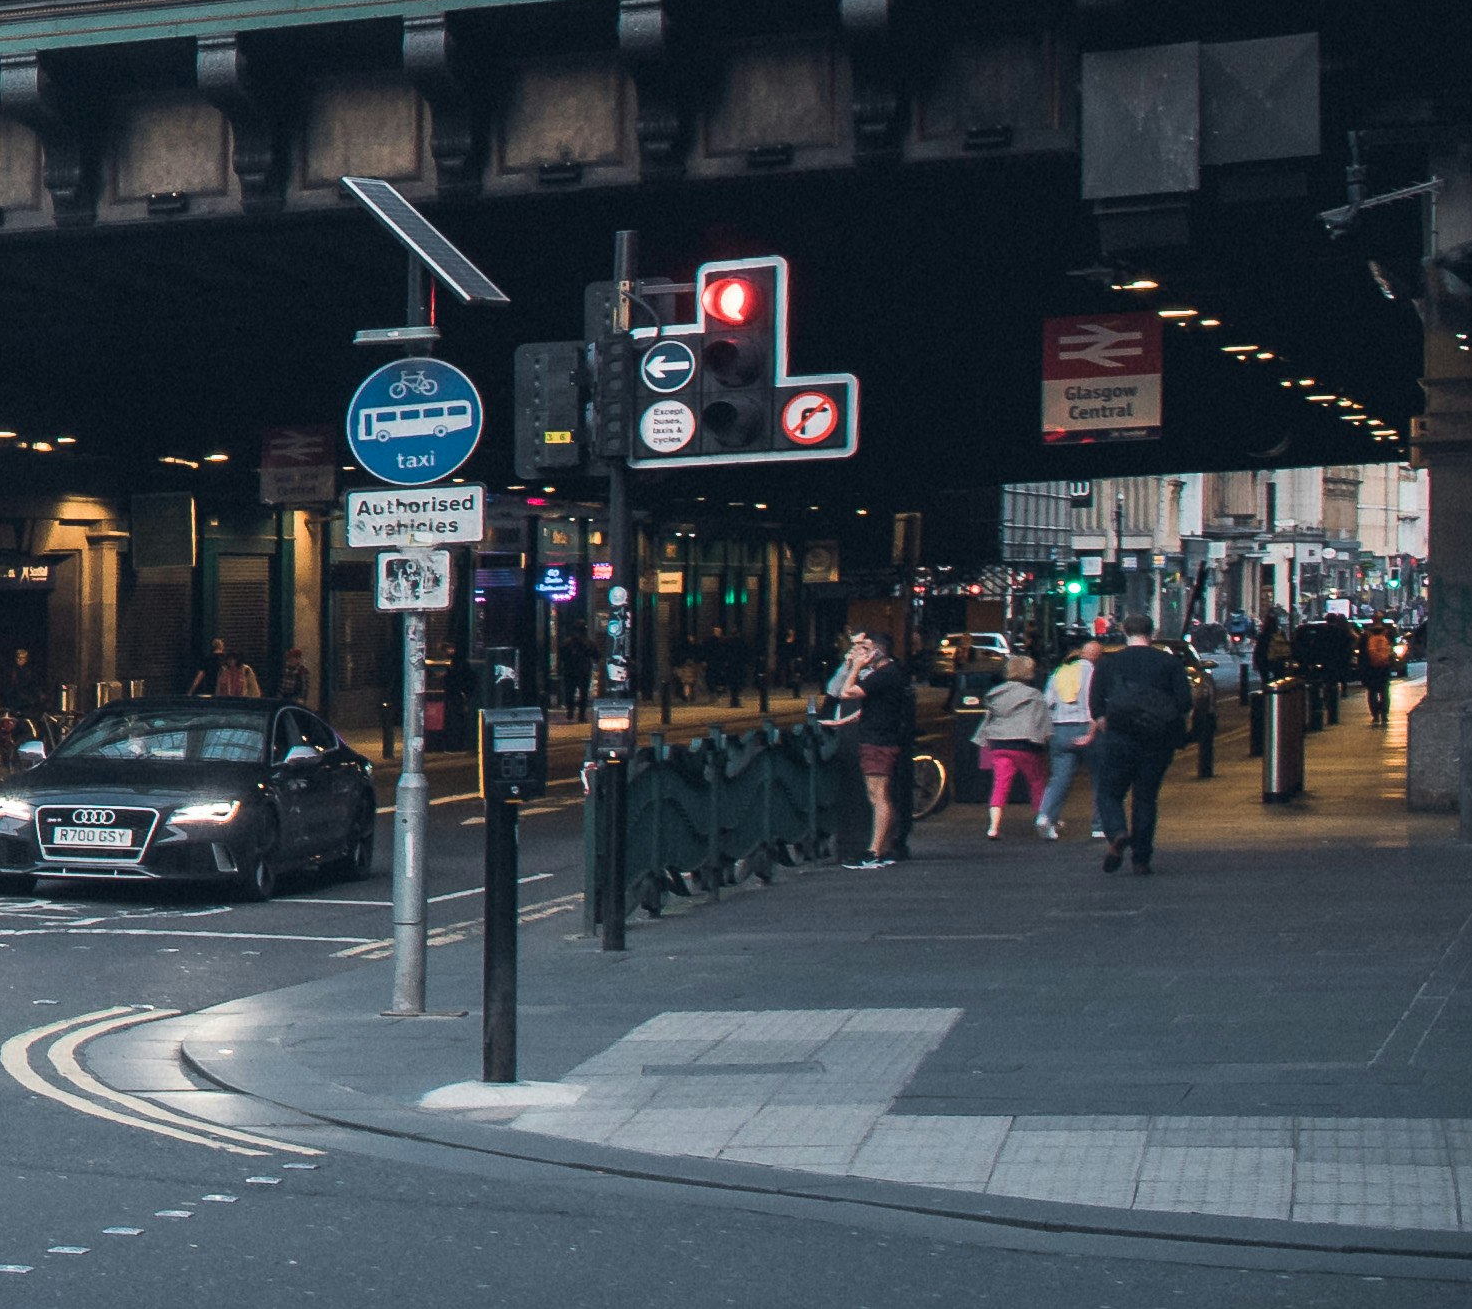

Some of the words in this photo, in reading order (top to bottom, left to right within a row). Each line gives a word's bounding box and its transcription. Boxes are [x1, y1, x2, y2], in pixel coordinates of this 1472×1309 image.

[1064, 385, 1138, 402] Glasgow
[1068, 402, 1134, 420] Central
[396, 450, 436, 469] taxi
[356, 493, 475, 517] Authorised
[371, 518, 459, 537] vehicles
[59, 828, 95, 842] R700
[98, 830, 125, 843] GSY
